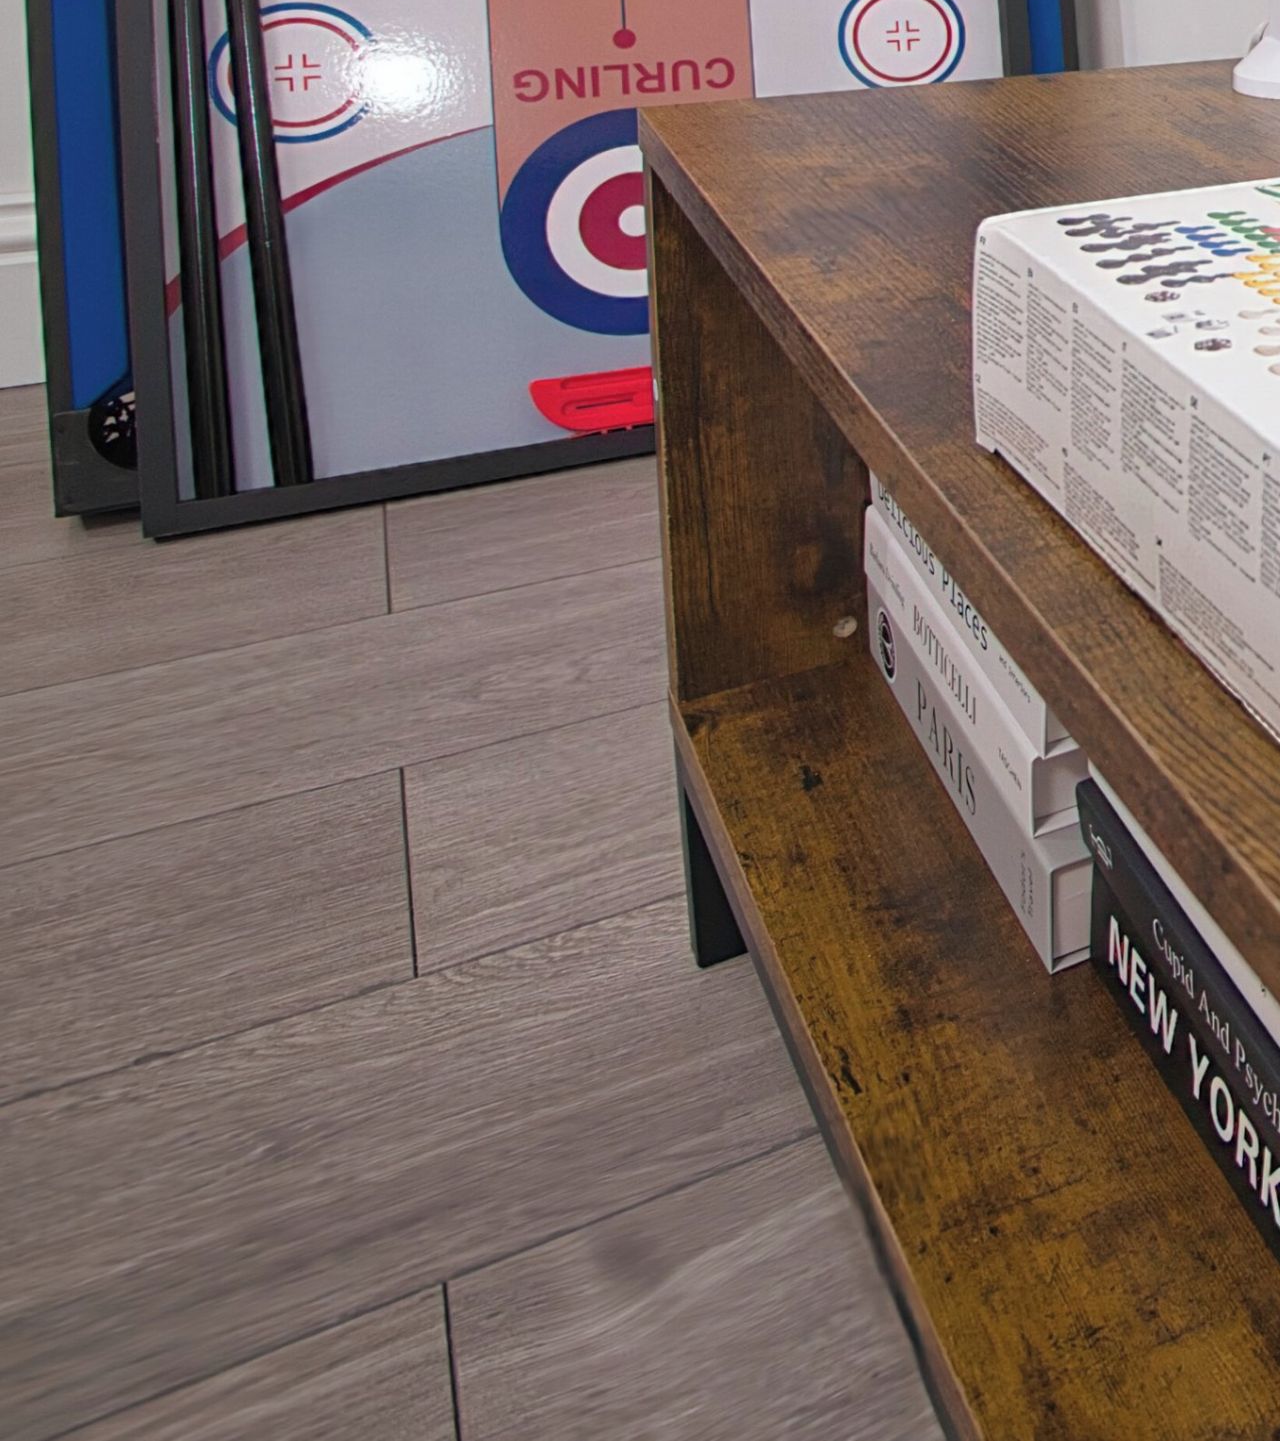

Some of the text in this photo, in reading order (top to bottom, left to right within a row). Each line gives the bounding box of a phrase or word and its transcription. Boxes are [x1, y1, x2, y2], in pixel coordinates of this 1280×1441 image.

[513, 58, 735, 102] CURLING
[913, 604, 977, 725] BOTTICELLI
[941, 565, 988, 651] Places
[916, 678, 977, 816] PARIS
[1107, 914, 1178, 1055] NEW
[1152, 917, 1195, 1000] Cupid
[1198, 988, 1230, 1054] And
